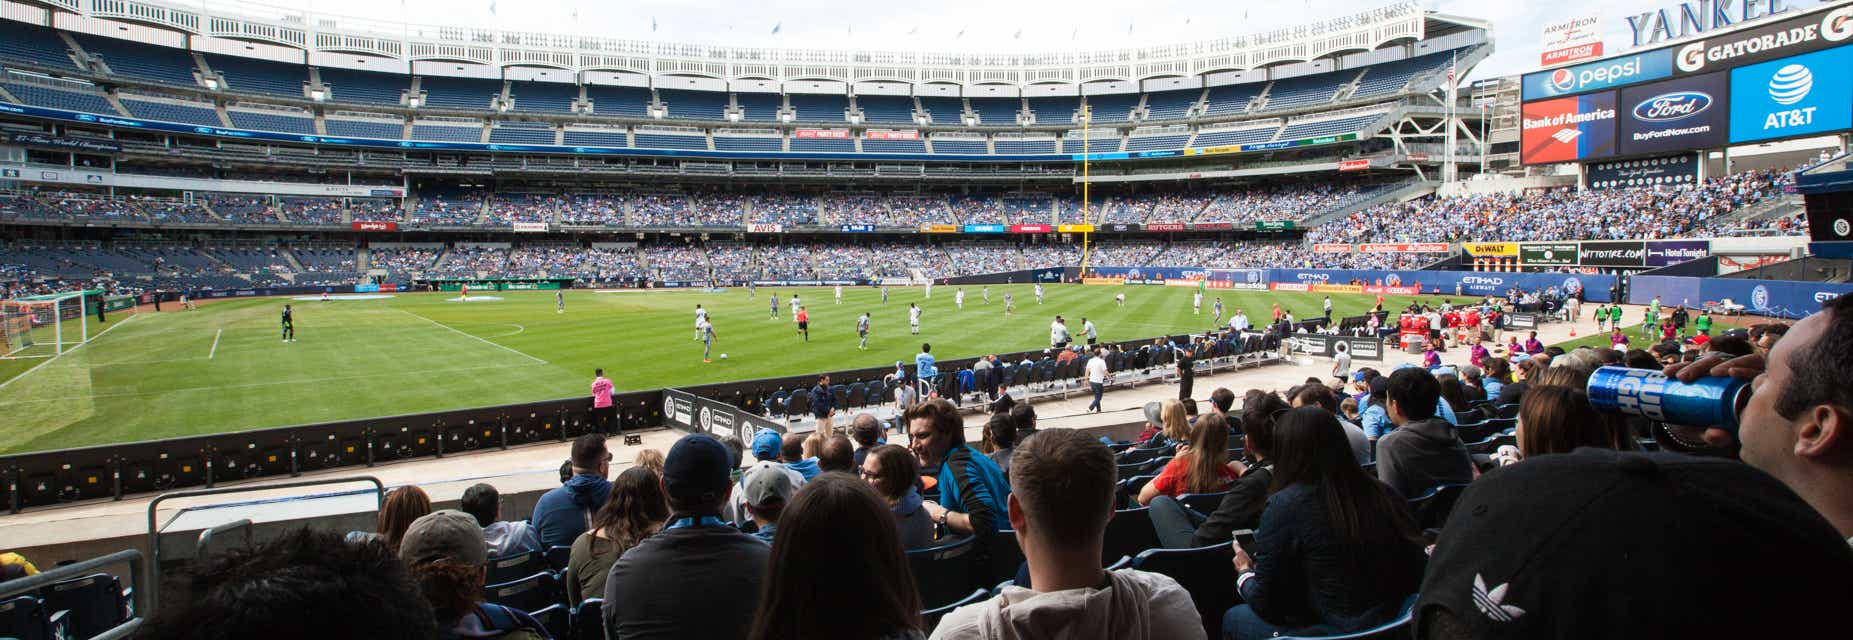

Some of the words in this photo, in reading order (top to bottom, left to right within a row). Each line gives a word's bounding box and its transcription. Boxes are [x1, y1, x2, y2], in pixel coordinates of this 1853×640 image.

[1543, 17, 1598, 35] ARMITRON
[1545, 45, 1594, 61] ARMITRON
[1677, 40, 1706, 72] G
[1707, 23, 1819, 63] GATORADE
[1578, 57, 1641, 88] pepsi
[1647, 94, 1698, 118] Ford
[1523, 116, 1551, 130] Bank
[1552, 114, 1565, 127] of
[1565, 108, 1616, 125] America
[1763, 107, 1817, 130] AT&T
[1633, 124, 1711, 142] BuyFordNow.com
[754, 223, 776, 232] AVIS
[1580, 248, 1645, 259] NITTOTIRE.COM
[1462, 276, 1504, 285] ETIHAD
